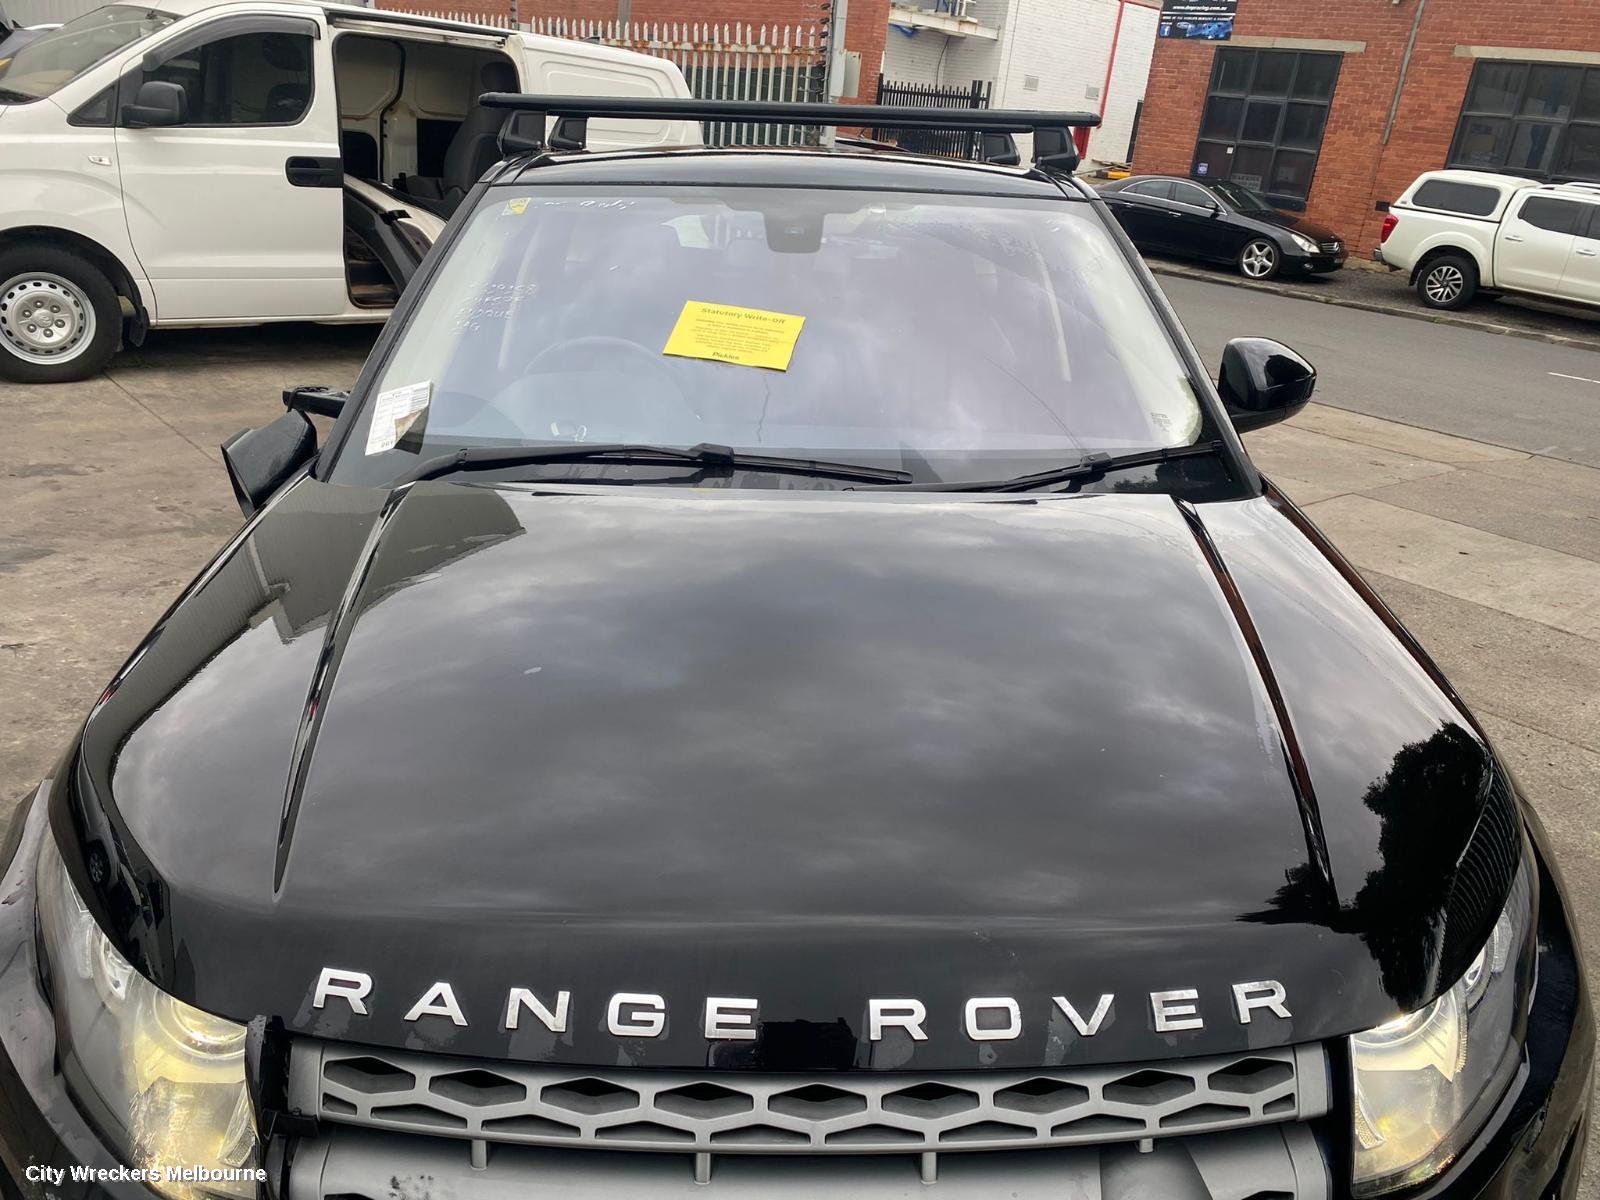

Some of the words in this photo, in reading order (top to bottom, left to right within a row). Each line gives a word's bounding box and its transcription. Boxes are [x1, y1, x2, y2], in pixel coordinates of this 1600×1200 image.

[701, 307, 741, 318] Statutory
[744, 313, 786, 324] Write-Off
[312, 967, 759, 1039] RANGE
[869, 980, 1292, 1041] ROVER
